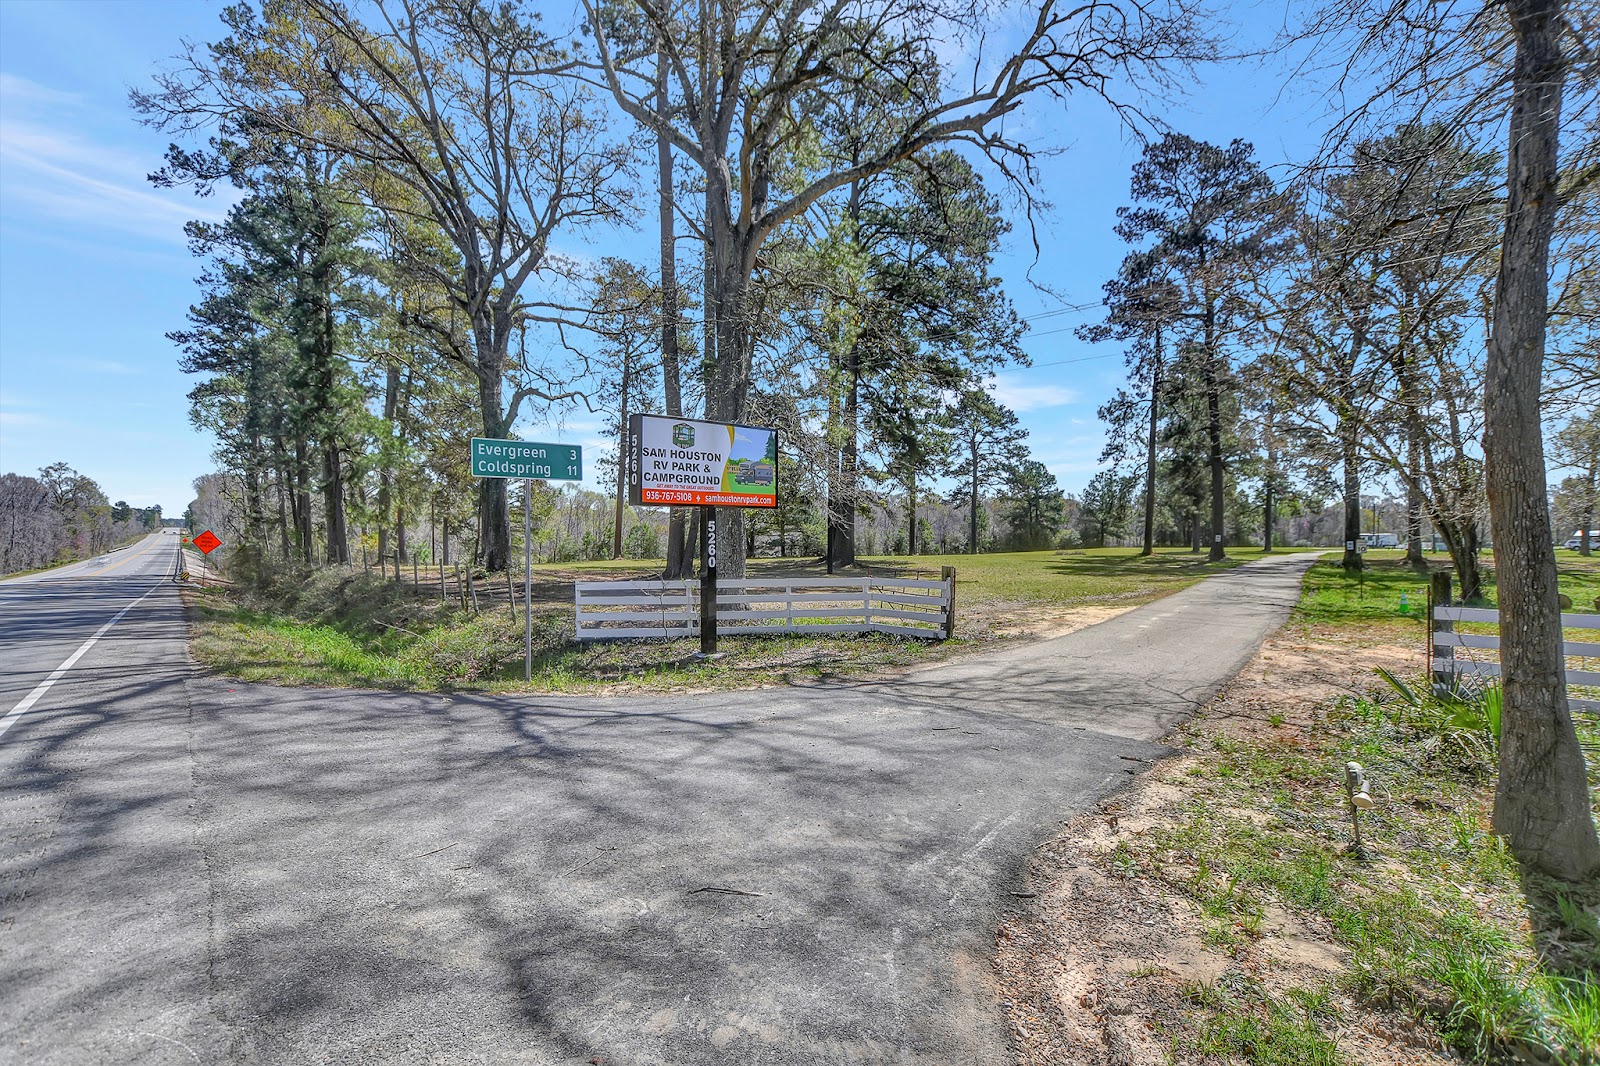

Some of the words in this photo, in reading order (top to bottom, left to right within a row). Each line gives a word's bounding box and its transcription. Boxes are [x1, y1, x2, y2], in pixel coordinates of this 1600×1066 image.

[478, 443, 547, 460] Evergreen
[570, 449, 577, 460] 3
[642, 447, 667, 458] SAM
[670, 449, 721, 462] HOUSTON
[478, 460, 551, 477] Coldspring
[567, 465, 577, 476] 11
[653, 460, 669, 470] RV
[672, 461, 701, 472] PARK
[703, 464, 711, 473] &
[643, 472, 720, 485] CAMPGROUND
[646, 490, 692, 502] 936-767-5108
[704, 494, 772, 505] samhoustonrvpark.com
[707, 520, 716, 568] 5260
